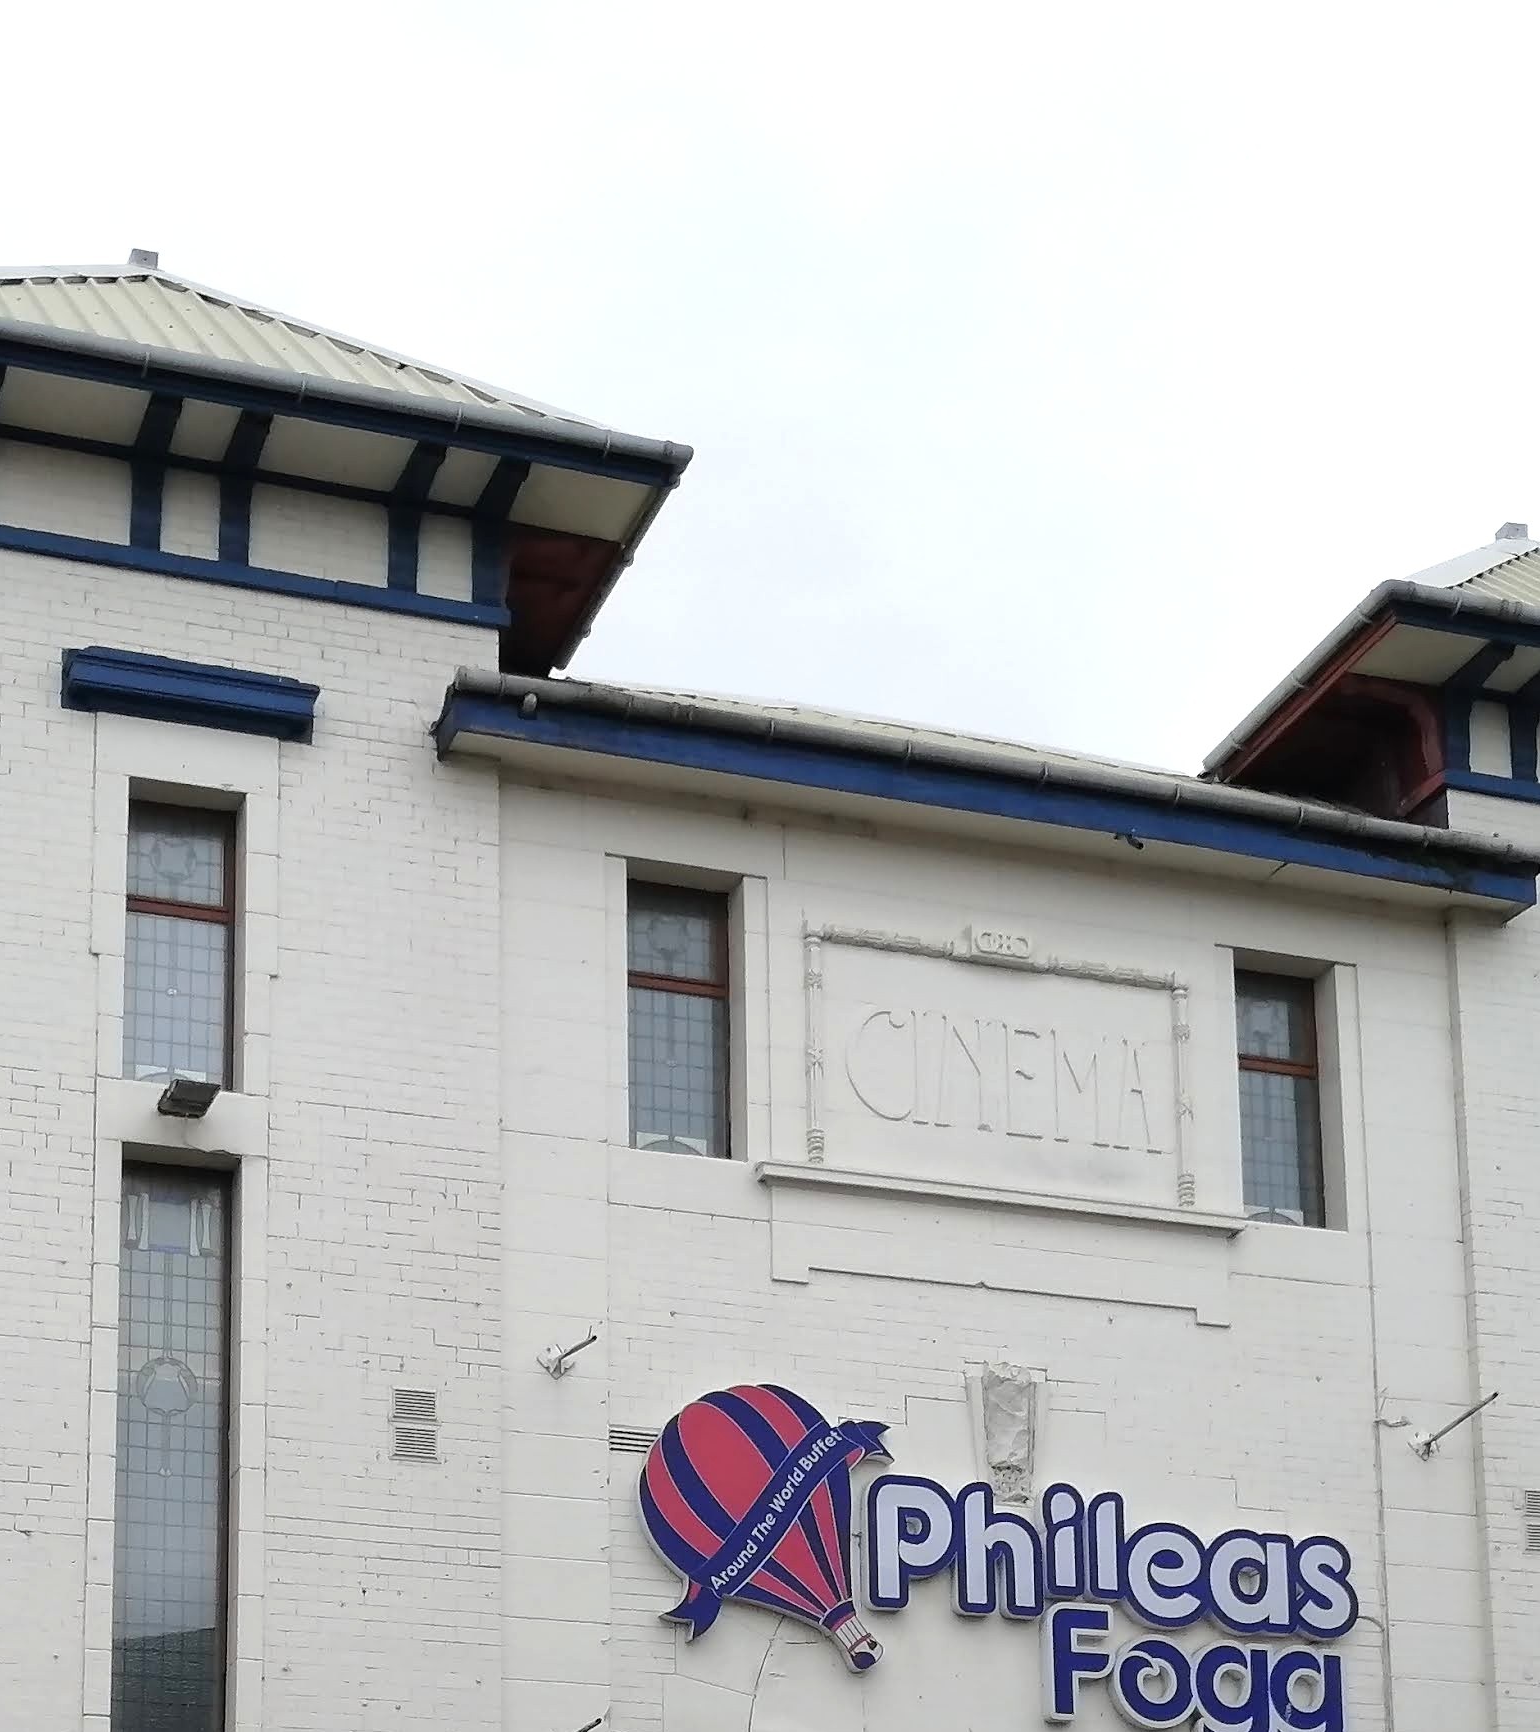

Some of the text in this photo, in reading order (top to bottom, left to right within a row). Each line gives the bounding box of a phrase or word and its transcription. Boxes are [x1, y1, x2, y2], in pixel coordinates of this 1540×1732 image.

[845, 1010, 1164, 1155] CINEMA
[711, 1430, 843, 1590] Around The World Buffet
[869, 1477, 1357, 1638] Phileas
